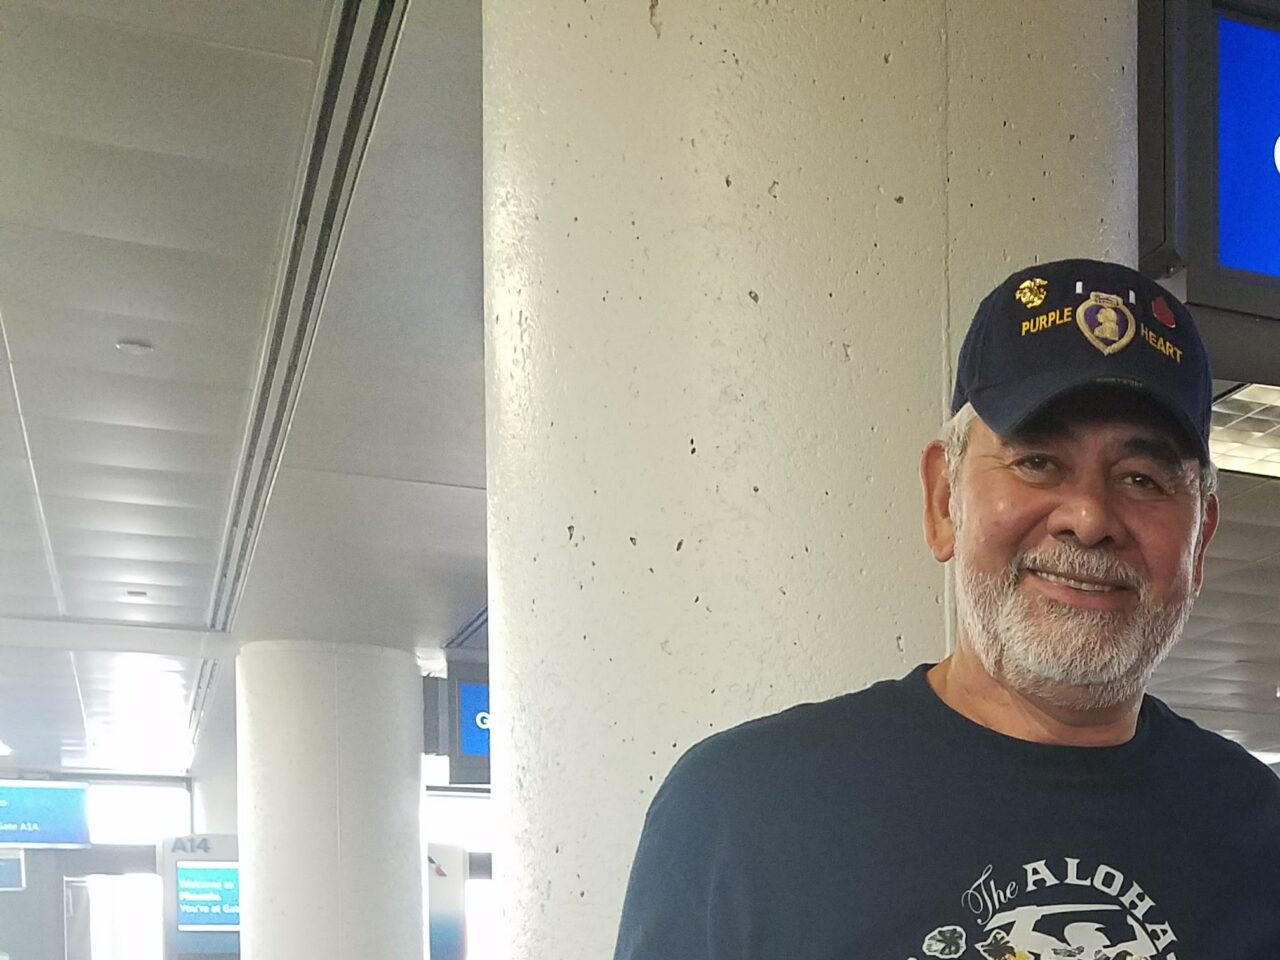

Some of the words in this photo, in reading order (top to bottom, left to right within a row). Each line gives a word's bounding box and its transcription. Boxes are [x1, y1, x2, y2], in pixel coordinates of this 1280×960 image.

[1021, 306, 1073, 337] PURPLE
[1140, 323, 1183, 363] HEART
[171, 837, 211, 853] A14
[961, 864, 1019, 925] The
[1022, 857, 1179, 952] ALOHA
